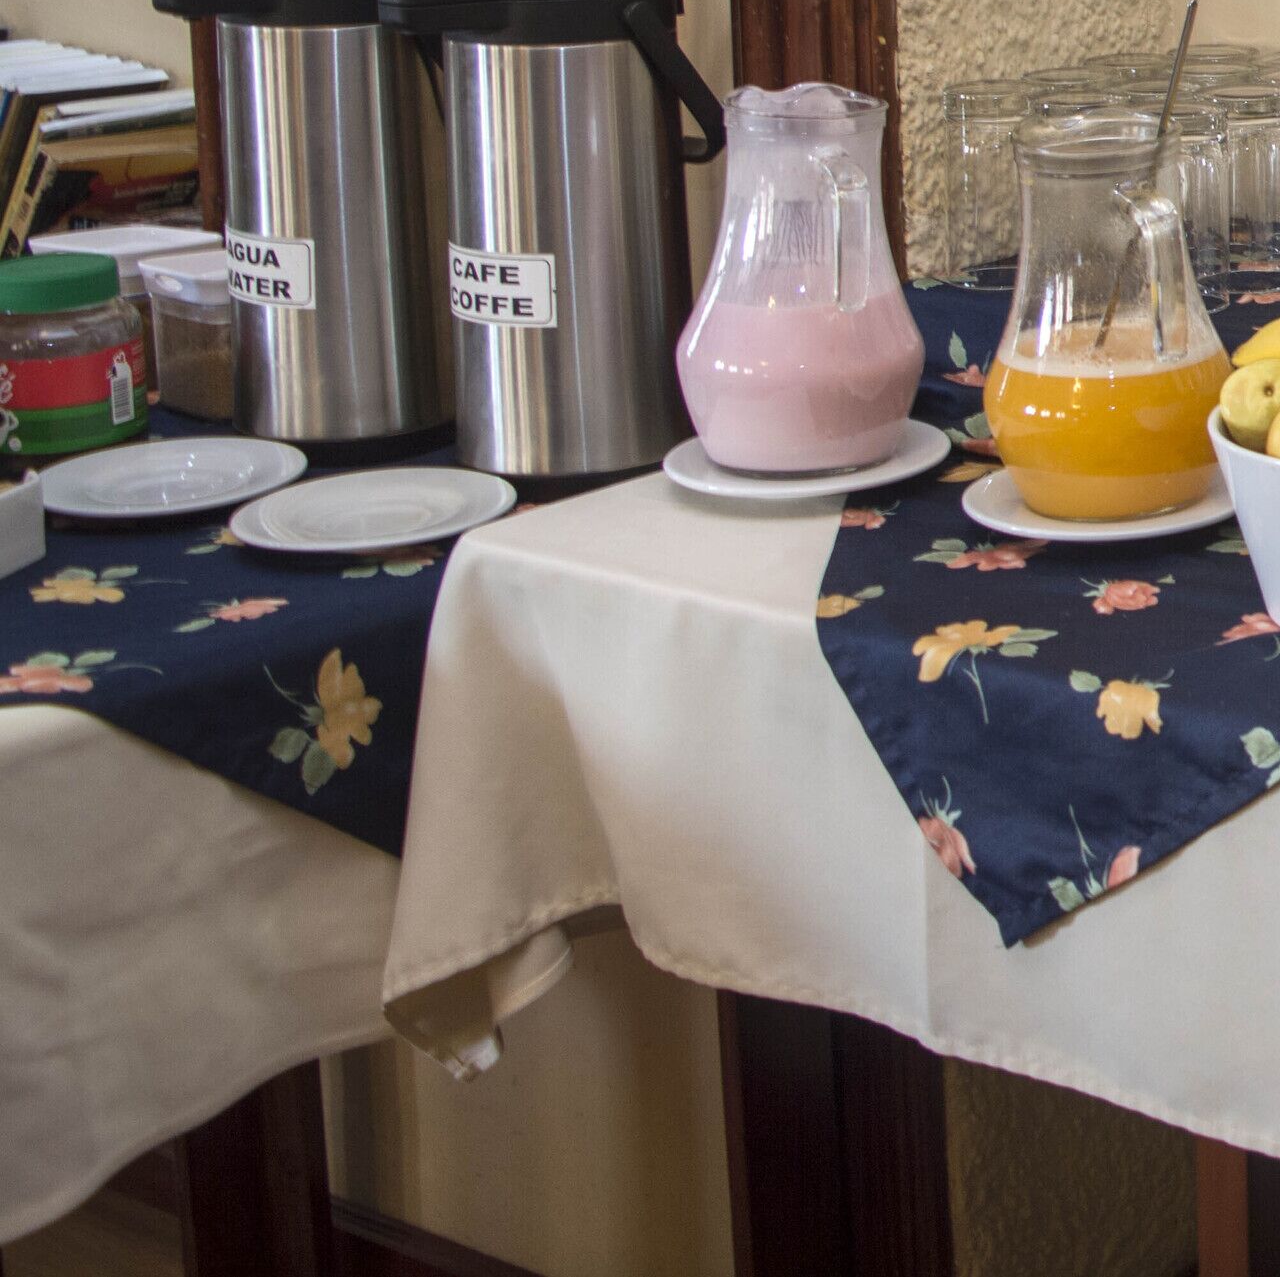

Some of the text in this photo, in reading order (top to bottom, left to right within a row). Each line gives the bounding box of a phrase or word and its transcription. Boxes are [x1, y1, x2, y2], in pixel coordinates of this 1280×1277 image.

[228, 238, 280, 268] AGUA
[453, 257, 520, 285] CAFE
[451, 286, 534, 317] COFFE
